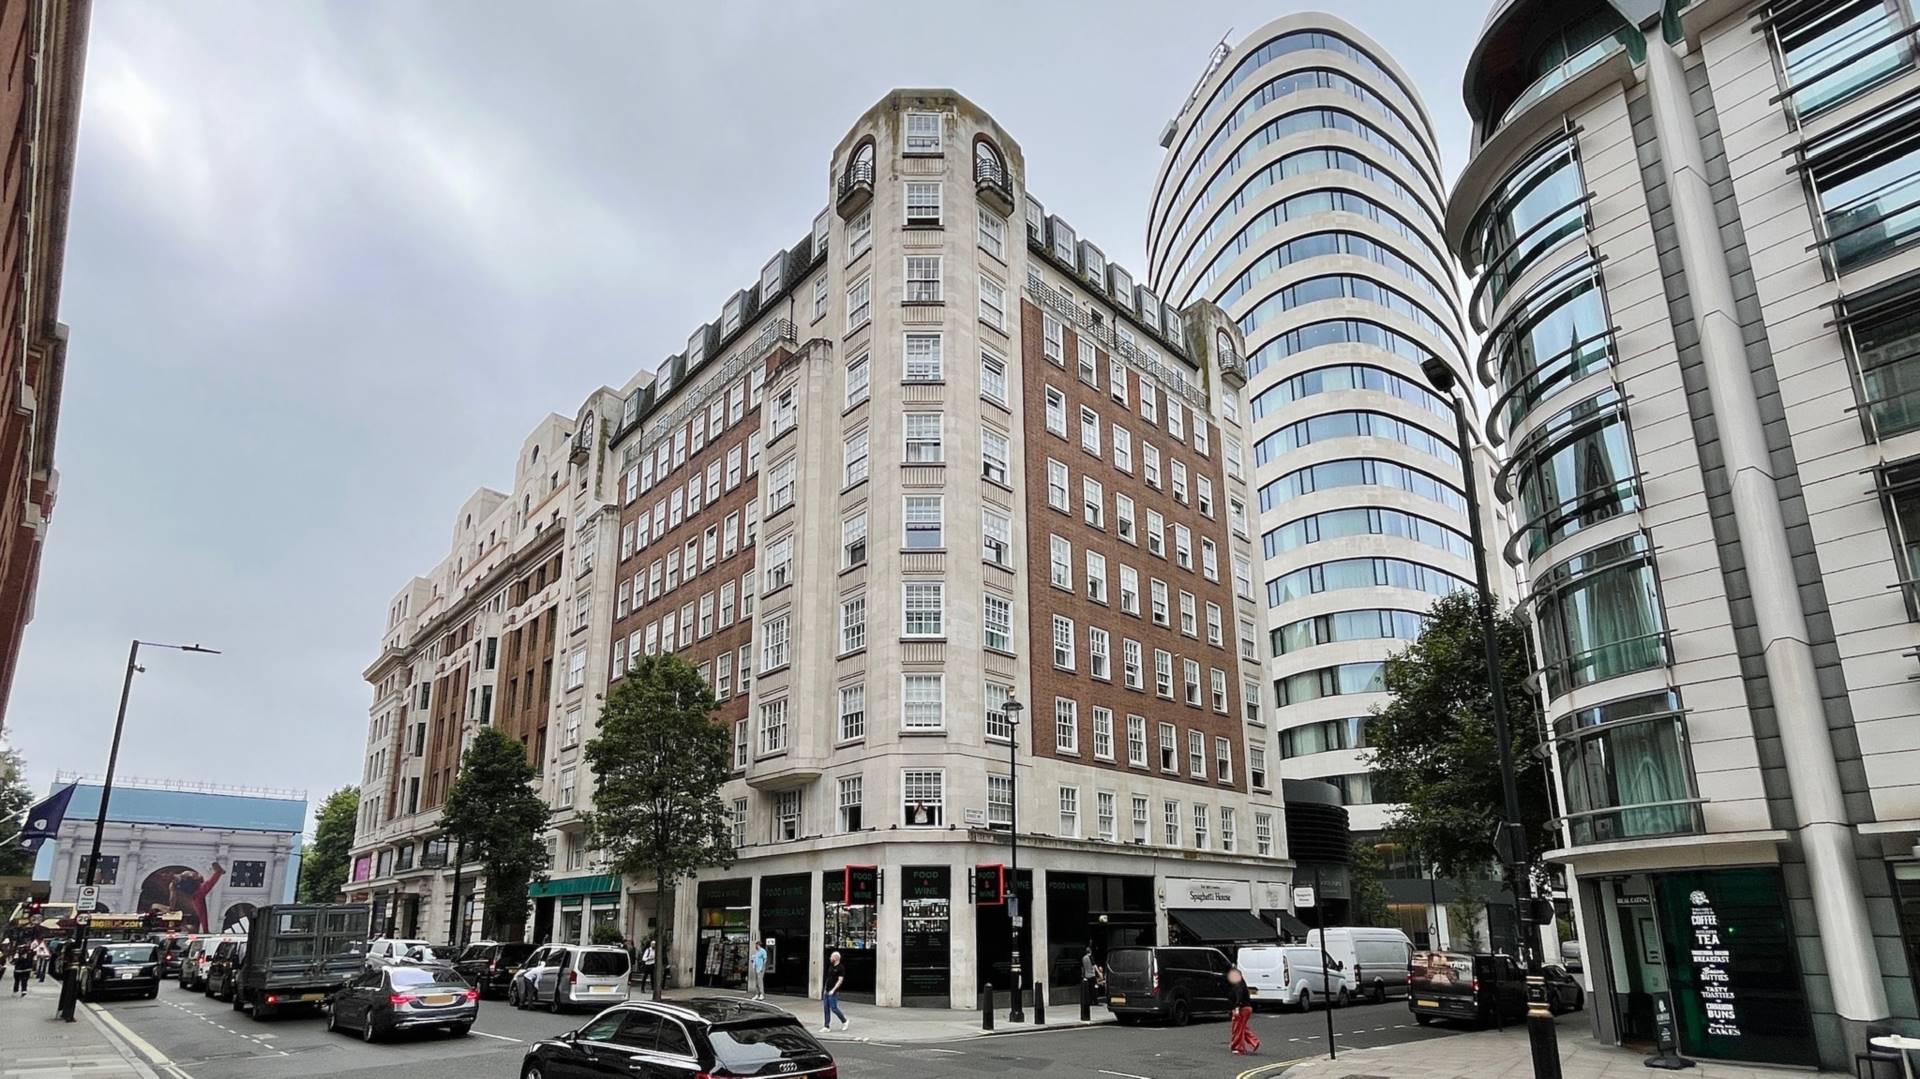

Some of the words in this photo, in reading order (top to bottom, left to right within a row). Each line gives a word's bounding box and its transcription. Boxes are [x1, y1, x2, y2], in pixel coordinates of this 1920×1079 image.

[853, 871, 873, 880] FOOD
[912, 871, 939, 879] FOOD
[977, 871, 996, 880] FOOD
[853, 891, 872, 899] WINE
[914, 887, 938, 896] WINE
[978, 890, 996, 898] WINE
[1190, 891, 1214, 902] Spaghetti
[1215, 892, 1231, 901] House
[1691, 915, 1718, 925] COFFEE
[1429, 922, 1436, 935] 6
[1695, 934, 1720, 945] TEA
[1700, 991, 1736, 999] TOASTIES
[1707, 1010, 1736, 1019] BUNS
[1708, 1027, 1741, 1036] CAKES
